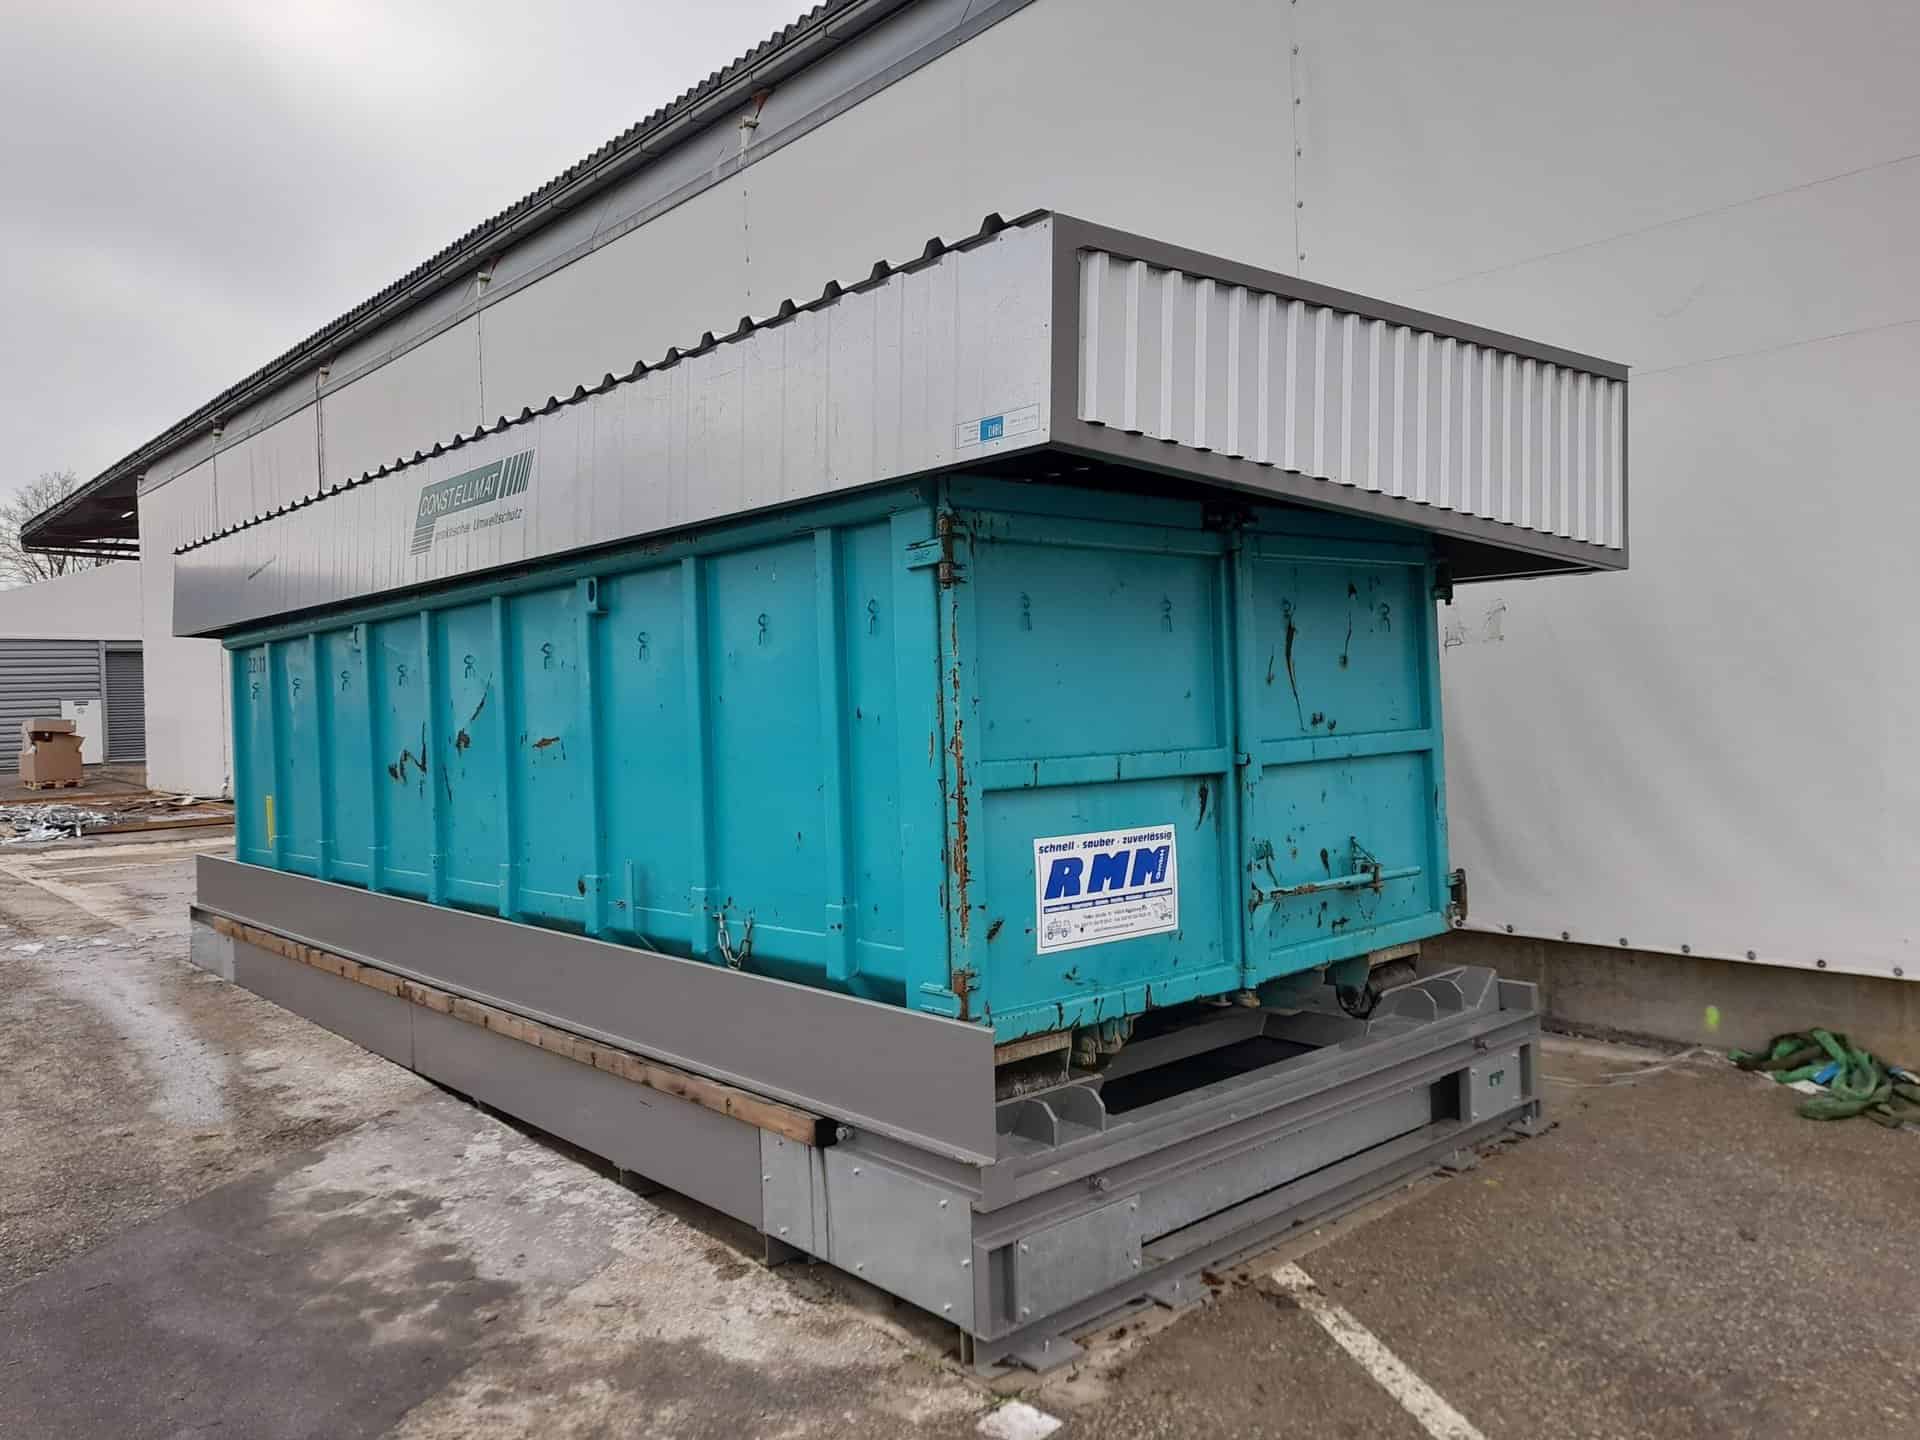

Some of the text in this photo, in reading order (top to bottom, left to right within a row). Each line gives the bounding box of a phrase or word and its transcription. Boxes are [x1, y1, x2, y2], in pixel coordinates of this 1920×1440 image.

[420, 473, 499, 516] CONSTELLMAT
[1038, 831, 1172, 854] schnell sauber zuverlässig
[1044, 845, 1170, 900] RMM
